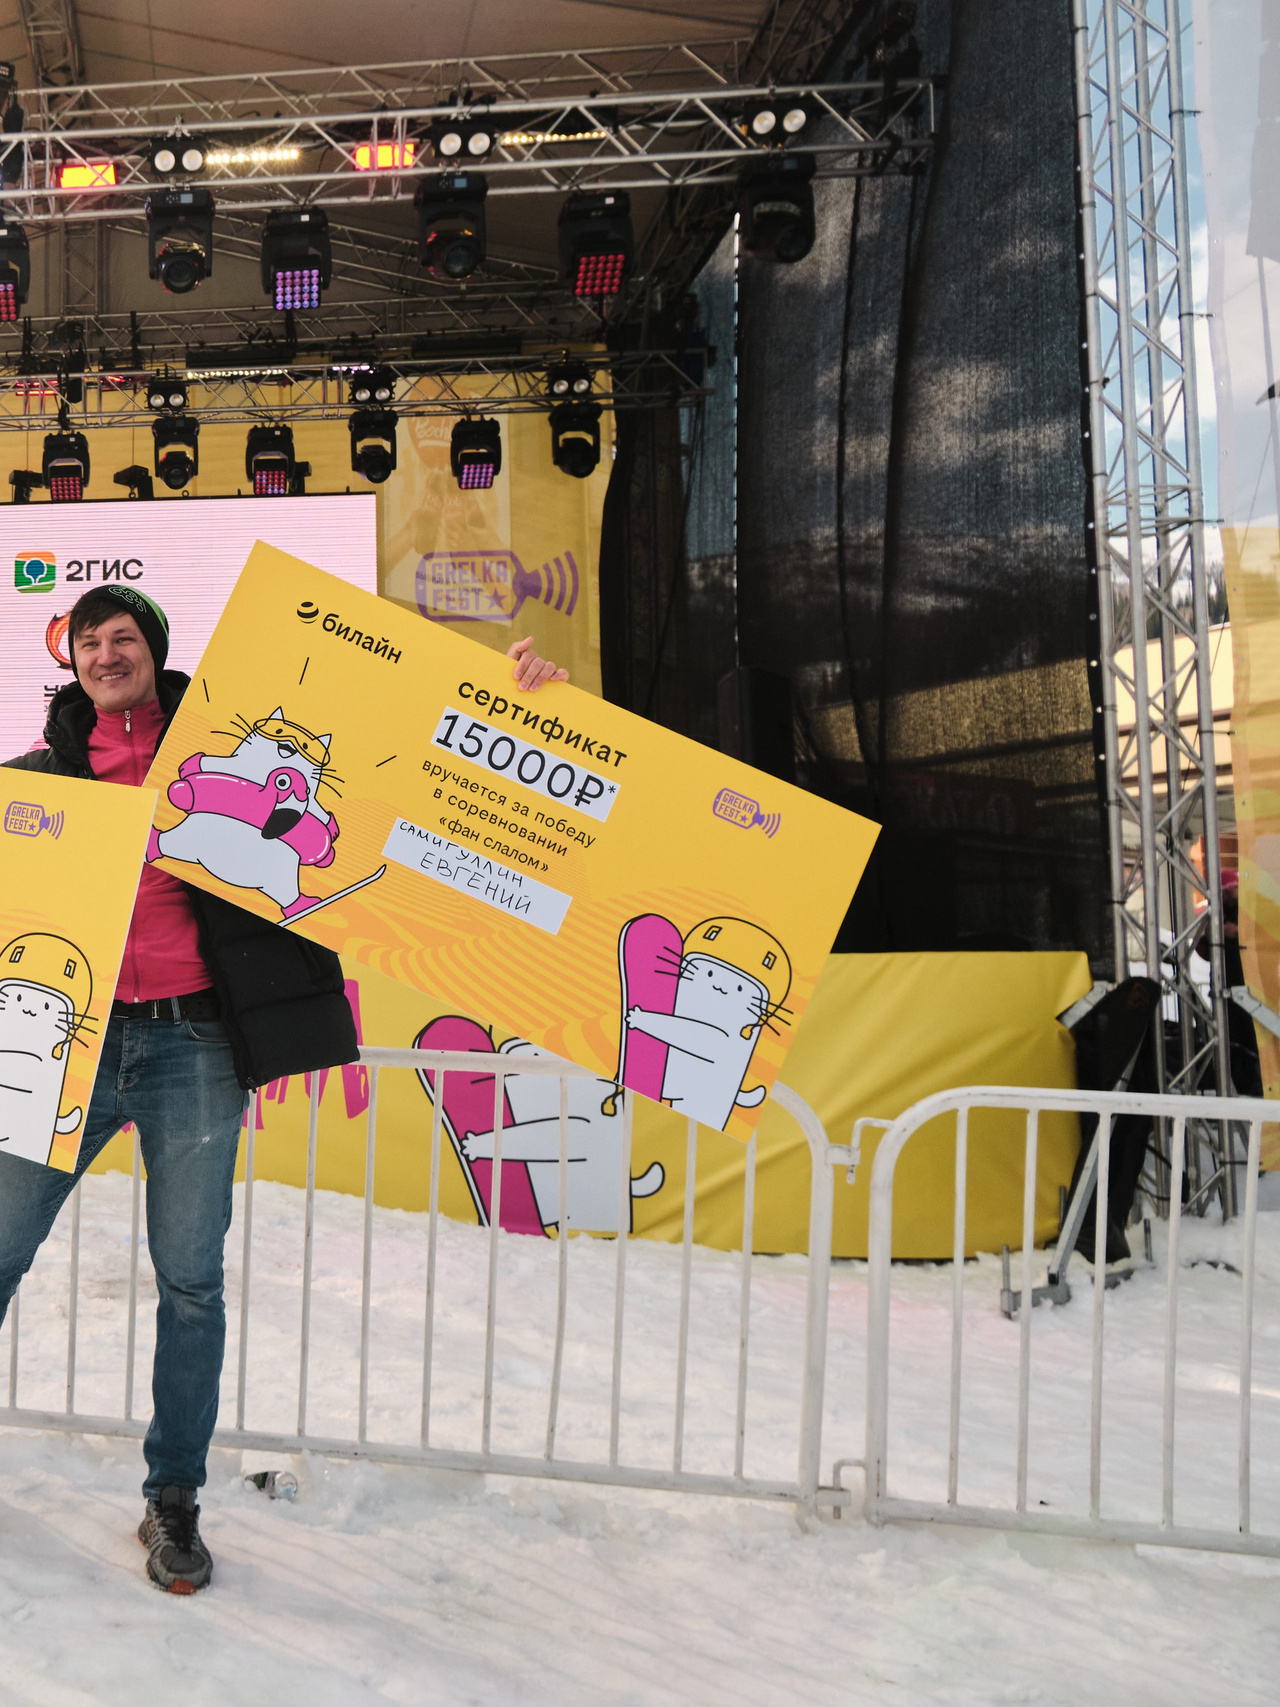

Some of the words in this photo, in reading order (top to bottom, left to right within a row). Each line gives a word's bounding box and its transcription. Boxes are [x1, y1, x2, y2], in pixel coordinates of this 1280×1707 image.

[65, 558, 144, 582] 2ГИС
[431, 560, 509, 585] GRELKA
[432, 588, 481, 612] FEST
[322, 612, 403, 664] билайн
[458, 681, 628, 768] сертификат
[11, 805, 41, 821] GRELKA
[421, 760, 508, 806] вручается
[511, 801, 531, 817] за
[534, 811, 597, 849] победу
[718, 803, 741, 820] FEST
[723, 792, 755, 815] GRELKA
[8, 817, 29, 831] FEST
[433, 787, 443, 799] в
[447, 795, 568, 857] соревновании
[439, 816, 481, 842] «фан
[483, 836, 549, 872] слалом»
[420, 852, 531, 914] ЕВГЕНИЙ
